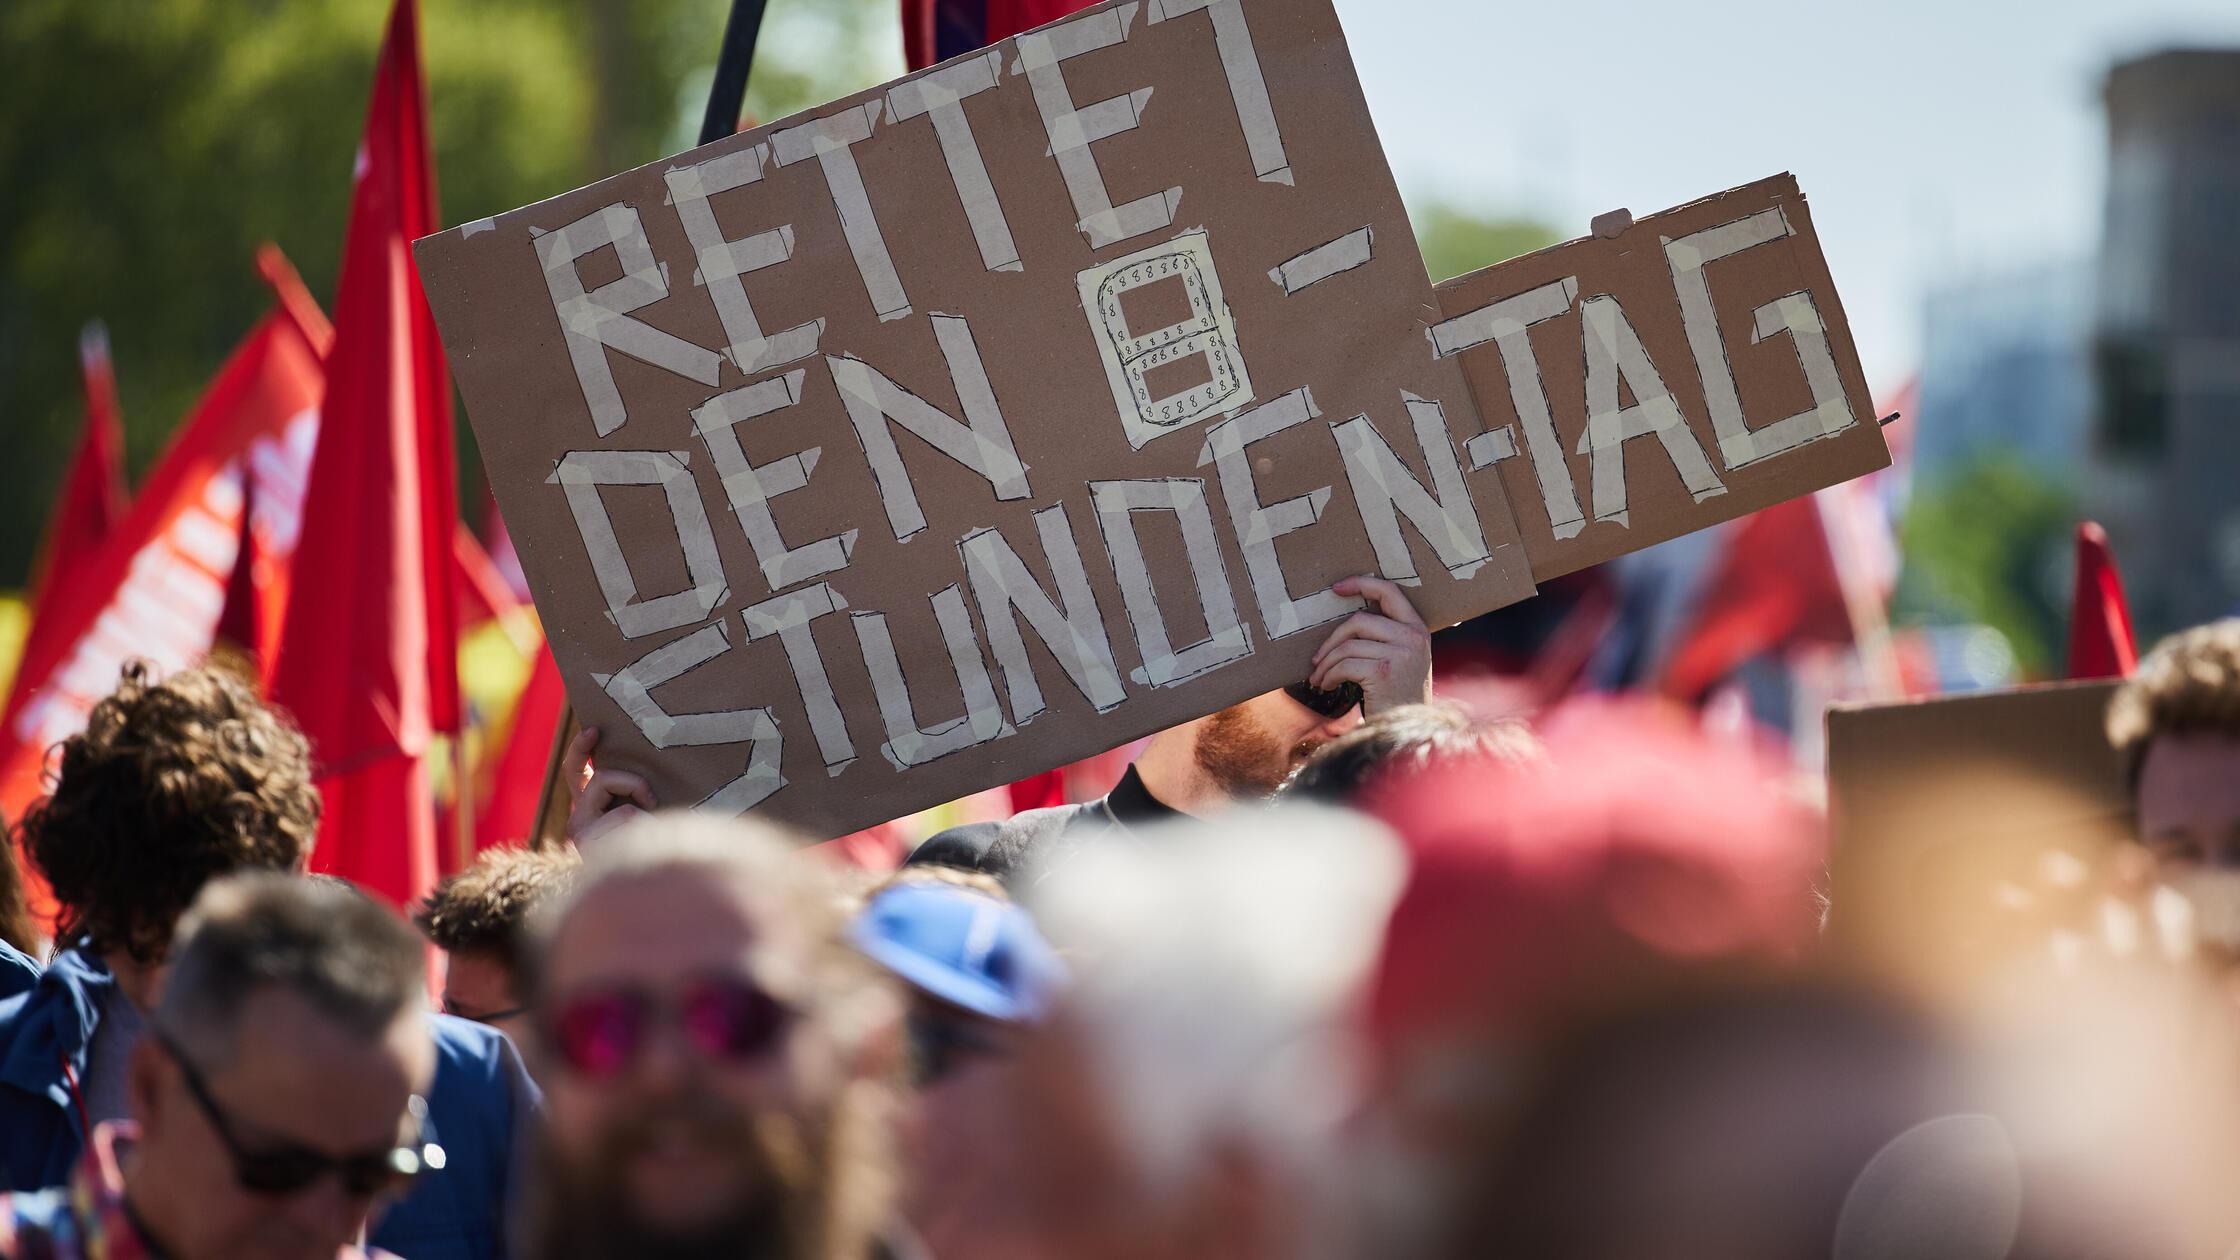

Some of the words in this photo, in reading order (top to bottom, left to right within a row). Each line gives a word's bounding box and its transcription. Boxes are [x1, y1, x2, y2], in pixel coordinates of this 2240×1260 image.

[528, 0, 1295, 438] RETTET
[545, 311, 1034, 641] DEN
[591, 204, 1861, 819] STUNDEN-TAG
